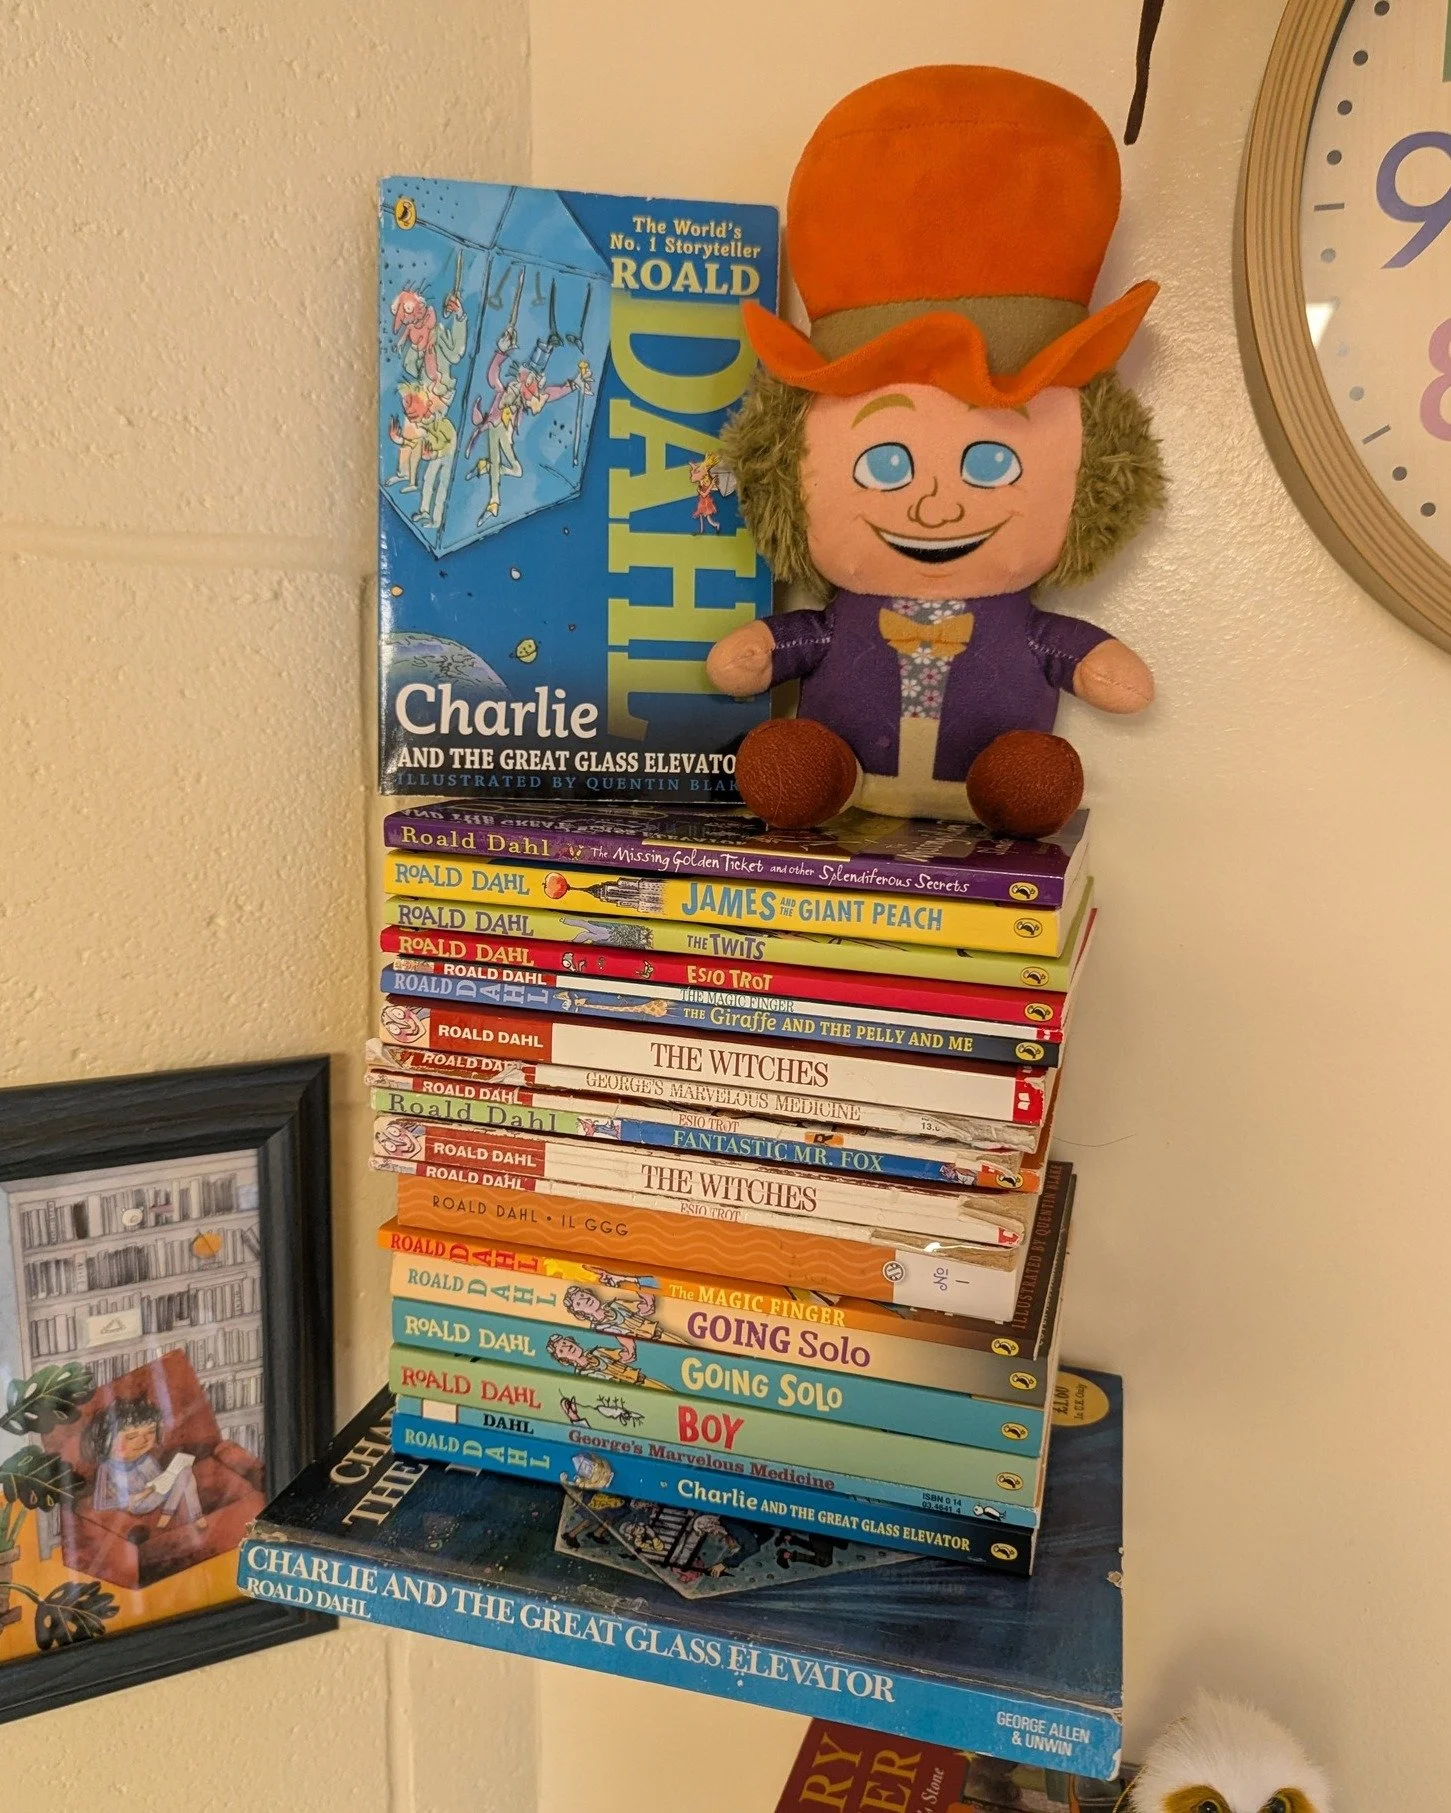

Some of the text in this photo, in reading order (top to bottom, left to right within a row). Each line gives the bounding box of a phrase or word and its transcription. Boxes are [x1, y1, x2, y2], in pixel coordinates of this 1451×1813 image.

[610, 234, 761, 260] No. 1 Storyteller
[633, 216, 742, 239] The World's
[610, 257, 761, 297] ROALD
[608, 299, 758, 742] DAHL
[395, 682, 599, 740] Charlie
[397, 772, 739, 793] ILLUSTRATED BY QUENTIN BLAK
[398, 747, 737, 775] AND THE GREAT GLASS ELEVATO
[400, 826, 970, 893] Roald Dahl The Missing Golden Ticket and other Splendiferous Secrets
[395, 863, 943, 931] ROALD DAHL JAMES AND THE GIANT PEACH
[398, 904, 766, 961] ROALD DAHL THE TWITS
[398, 935, 773, 991] ROALD DAHL ESIO TROT
[443, 963, 795, 1013] ROALD DAHL THE MAGIC FINGER
[394, 972, 974, 1053] ROALD DAHL THE Giraffe AND THE PELLY AND ME
[438, 1024, 830, 1088] ROALD DAHL THE WITCHES
[421, 1053, 479, 1069] ROALD
[585, 1070, 665, 1096] GEORGE'S
[669, 1082, 769, 1110] MARVELOUS
[774, 1094, 862, 1121] MEDICINE
[422, 1080, 740, 1133] ROALD DAHL ESIO TROT
[389, 1092, 885, 1173] Roald Dahl FANTASTIC MR. FOX
[425, 1165, 741, 1222] ROALD DAHL ESIO TROT
[433, 1142, 818, 1212] ROALD DAHL THE WITCHES
[1044, 1164, 1063, 1191] BLAKE
[432, 1195, 629, 1237] ROALD DAHL IL GGG
[1035, 1193, 1057, 1236] QUENTIN
[1031, 1238, 1048, 1252] BY
[390, 1233, 846, 1327] ROALD DAHL The MAGIC FINGER
[1011, 1255, 1042, 1330] ILLUSTRATED
[407, 1268, 871, 1368] ROALD DAHL GOING Solo
[404, 1315, 844, 1413] ROALD DAHL GOING SOLO
[400, 1365, 746, 1452] ROALD DAHL BOY
[330, 1406, 397, 1485] CHA
[483, 1413, 835, 1491] DAHL George's Marvelous Medicine
[341, 1460, 430, 1527] THE
[404, 1428, 460, 1453] ROALD
[462, 1439, 551, 1470] DAHL
[677, 1478, 759, 1511] Charlie
[760, 1499, 787, 1516] AND
[789, 1504, 815, 1522] THE
[817, 1509, 860, 1530] GREAT
[861, 1519, 901, 1538] GLASS
[903, 1527, 971, 1552] ELEVATOR
[922, 1492, 944, 1502] ISBN
[953, 1498, 962, 1507] 14
[246, 1576, 371, 1619] ROALD DAHL
[247, 1545, 896, 1703] CHARLIE AND THE GREAT GLASS ELEVATOR
[996, 1710, 1091, 1745] GEORGE ALLEN
[1011, 1731, 1073, 1757] & UNWIN
[922, 1766, 947, 1803] Stone
